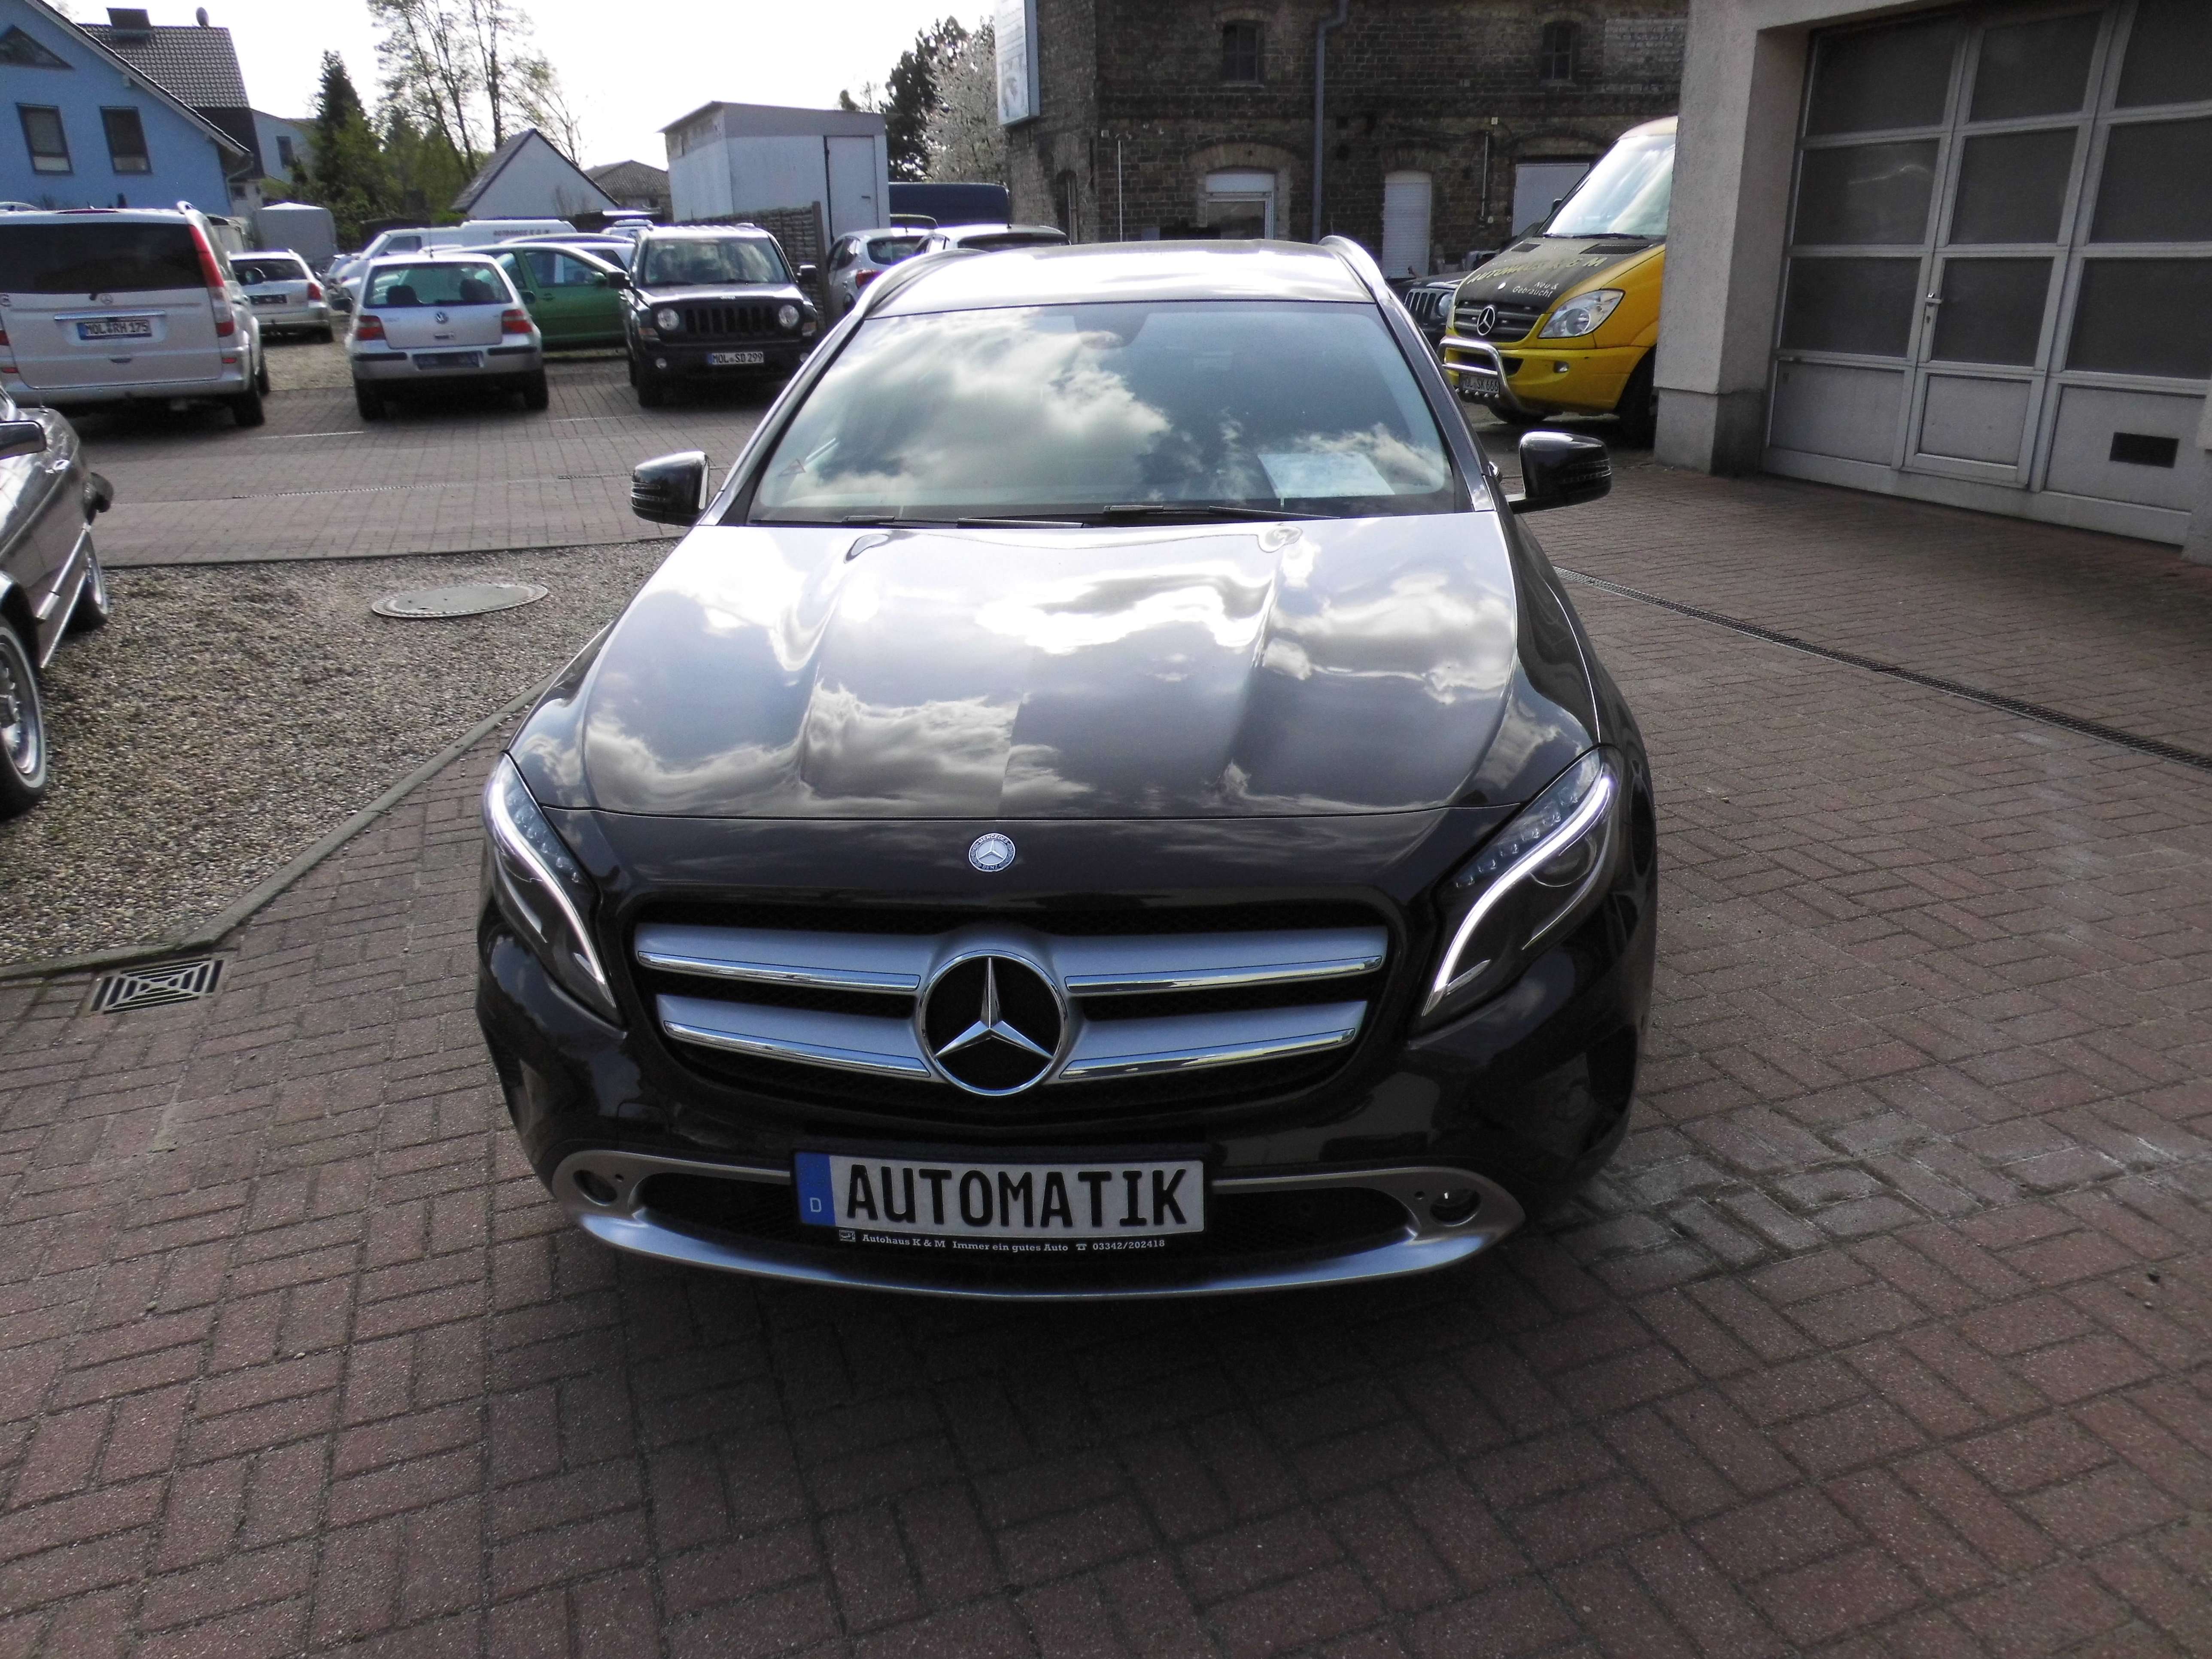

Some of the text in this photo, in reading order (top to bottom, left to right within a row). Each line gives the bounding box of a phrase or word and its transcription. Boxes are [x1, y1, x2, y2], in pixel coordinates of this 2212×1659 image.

[1582, 257, 1608, 267] M
[1534, 281, 1550, 289] Neu
[1512, 285, 1555, 298] Gebraucht
[713, 353, 729, 364] MOL
[747, 352, 763, 362] 299
[1486, 380, 1498, 392] 666
[978, 834, 1009, 844] MERCEDES
[810, 1164, 1188, 1228] D AUTOMATIK
[862, 1234, 910, 1246] Autohaus
[934, 1240, 945, 1248] M
[952, 1241, 990, 1250] Immer
[1012, 1244, 1041, 1253] gutes
[1092, 1240, 1165, 1251] 03342/202418
